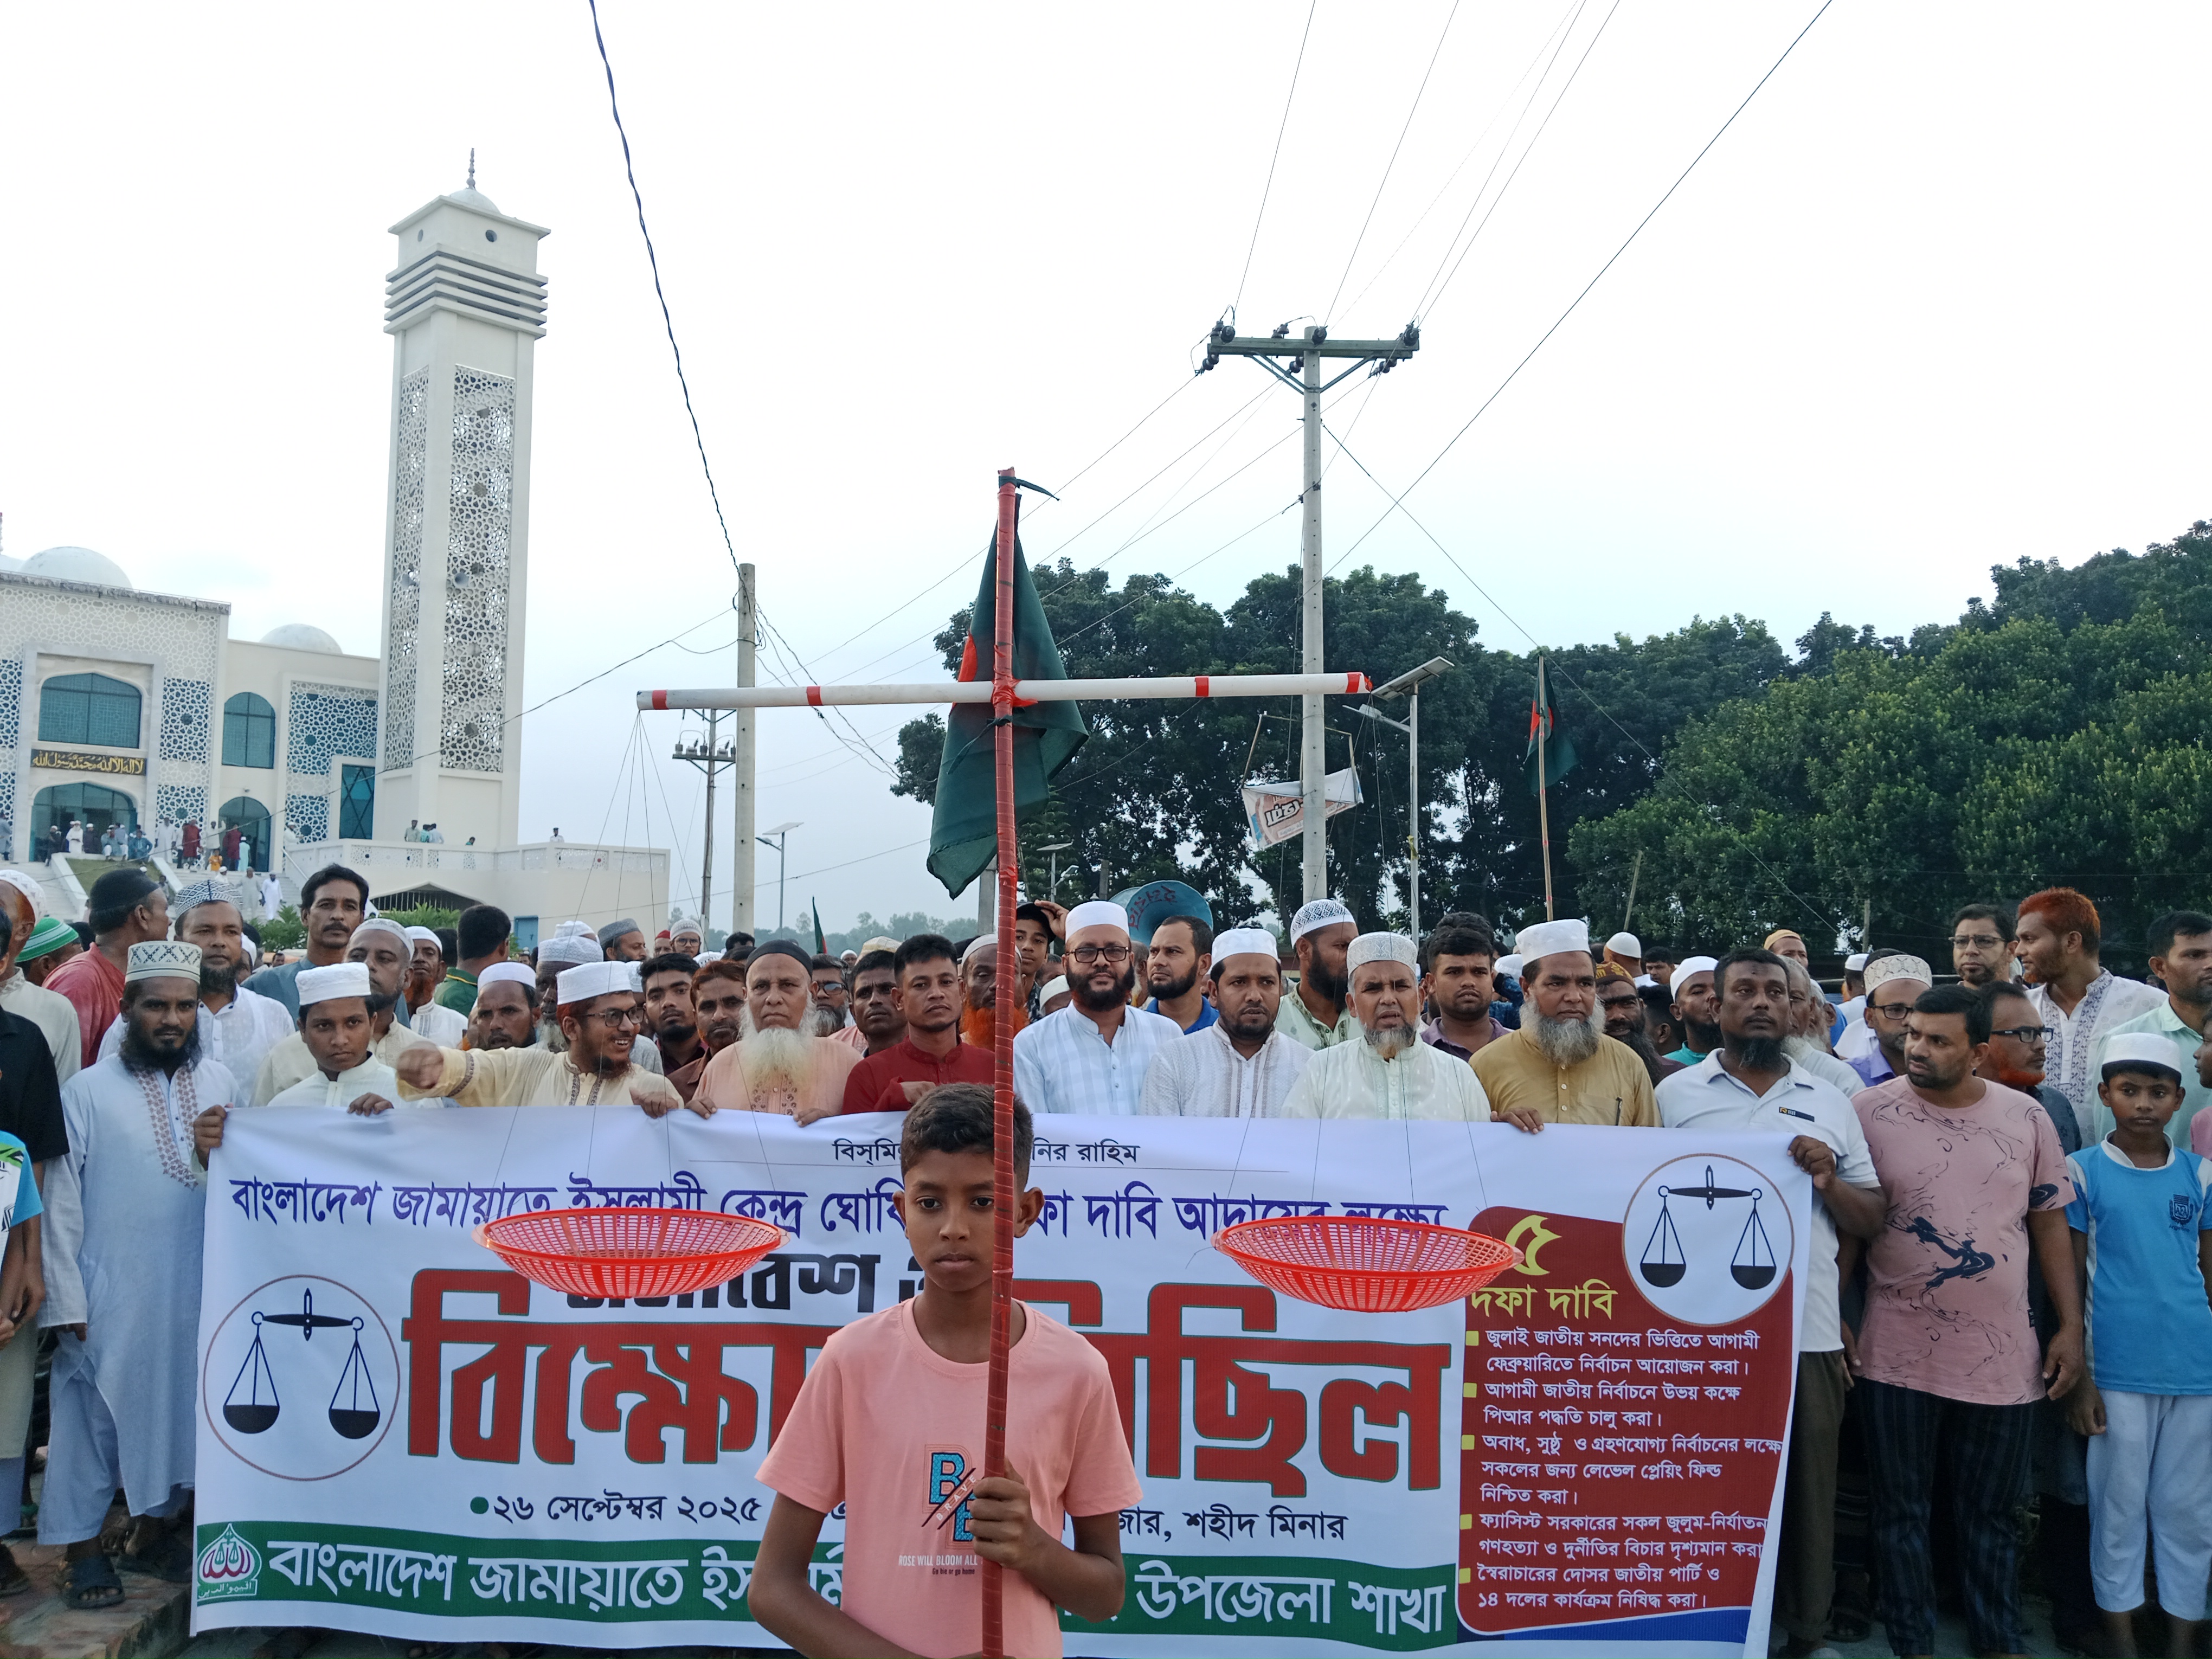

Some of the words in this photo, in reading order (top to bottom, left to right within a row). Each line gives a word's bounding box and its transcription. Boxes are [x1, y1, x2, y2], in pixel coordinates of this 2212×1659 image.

[1076, 1138, 1141, 1165] রাহিম
[229, 1175, 382, 1225] বাংলাদেশ
[391, 1181, 558, 1227] জামায়াতে
[1082, 1180, 1162, 1239] দাবি
[1505, 1215, 1561, 1275] ৫
[1471, 1284, 1538, 1319] দফা
[1545, 1278, 1618, 1320] দাবি
[1485, 1326, 1529, 1348] জুলাই
[1534, 1326, 1585, 1346] জাতীয়
[1589, 1332, 1642, 1347] সনদের
[1645, 1328, 1703, 1348] ভিত্তিতে
[1707, 1329, 1760, 1349] আগামী
[1487, 1352, 1575, 1373] ফেব্রুয়ারিতে
[1579, 1353, 1632, 1373] নির্বাচন
[1636, 1358, 1706, 1375] আয়োজন
[1484, 1378, 1538, 1399] আগামী
[1542, 1379, 1593, 1399] জাতীয়
[1597, 1380, 1658, 1400] নির্বাচনে
[1661, 1381, 1700, 1401] উভয়
[1703, 1386, 1742, 1400] কক্ষে
[1483, 1404, 1533, 1425] পিআর
[1539, 1405, 1584, 1426] পদ্ধতি
[1588, 1410, 1617, 1430] চালু
[1482, 1435, 1531, 1455] অবাধ,
[1536, 1431, 1562, 1456] সুষ্ঠু
[1574, 1438, 1587, 1451] ও
[1591, 1436, 1668, 1454] গ্রহণযোগ্য
[1671, 1433, 1740, 1453] নির্বাচনের
[1481, 1461, 1541, 1477] সকলের
[1545, 1463, 1578, 1478] জন্য
[1583, 1464, 1636, 1479] লেভেল
[1641, 1459, 1683, 1480] প্লেয়িং
[1687, 1459, 1722, 1478] ফিল্ড
[935, 1475, 976, 1521] BRAVE
[1480, 1483, 1533, 1503] নিশ্চিত
[493, 1497, 534, 1523] ২৬
[548, 1489, 667, 1521] সেপ্টেম্বর
[677, 1496, 762, 1525] ২০২৫
[1182, 1503, 1259, 1541] শহীদ
[1266, 1505, 1349, 1540] মিনার
[1479, 1510, 1543, 1529] ফ্যাসিস্ট
[1546, 1515, 1618, 1531] সরকারের
[1622, 1516, 1662, 1531] সকল
[898, 1555, 916, 1566] ROSE
[917, 1555, 934, 1566] WILL
[936, 1555, 962, 1566] BLOOM
[964, 1554, 978, 1566] ALL
[1479, 1538, 1539, 1556] গণহত্যা
[1544, 1543, 1557, 1555] ও
[1563, 1537, 1620, 1560] দুর্নীতির
[1624, 1538, 1666, 1557] বিচার
[1669, 1540, 1727, 1561] দৃশ্যমান
[1477, 1562, 1558, 1581] স্বৈরাচারের
[1564, 1567, 1610, 1583] দোসর
[1613, 1562, 1664, 1583] জাতীয়
[1669, 1562, 1703, 1582] পার্টি
[1707, 1569, 1720, 1580] ও
[267, 1541, 457, 1601] বাংলাদেশ
[468, 1557, 689, 1613] জামায়াতে
[1134, 1560, 1335, 1624] উপজেলা
[1348, 1581, 1446, 1636] শাখা
[1478, 1592, 1498, 1607] ১৪
[1505, 1592, 1549, 1607] দলের
[1553, 1589, 1613, 1608] কার্যক্রম
[1617, 1589, 1662, 1608] নিষিদ্ধ
